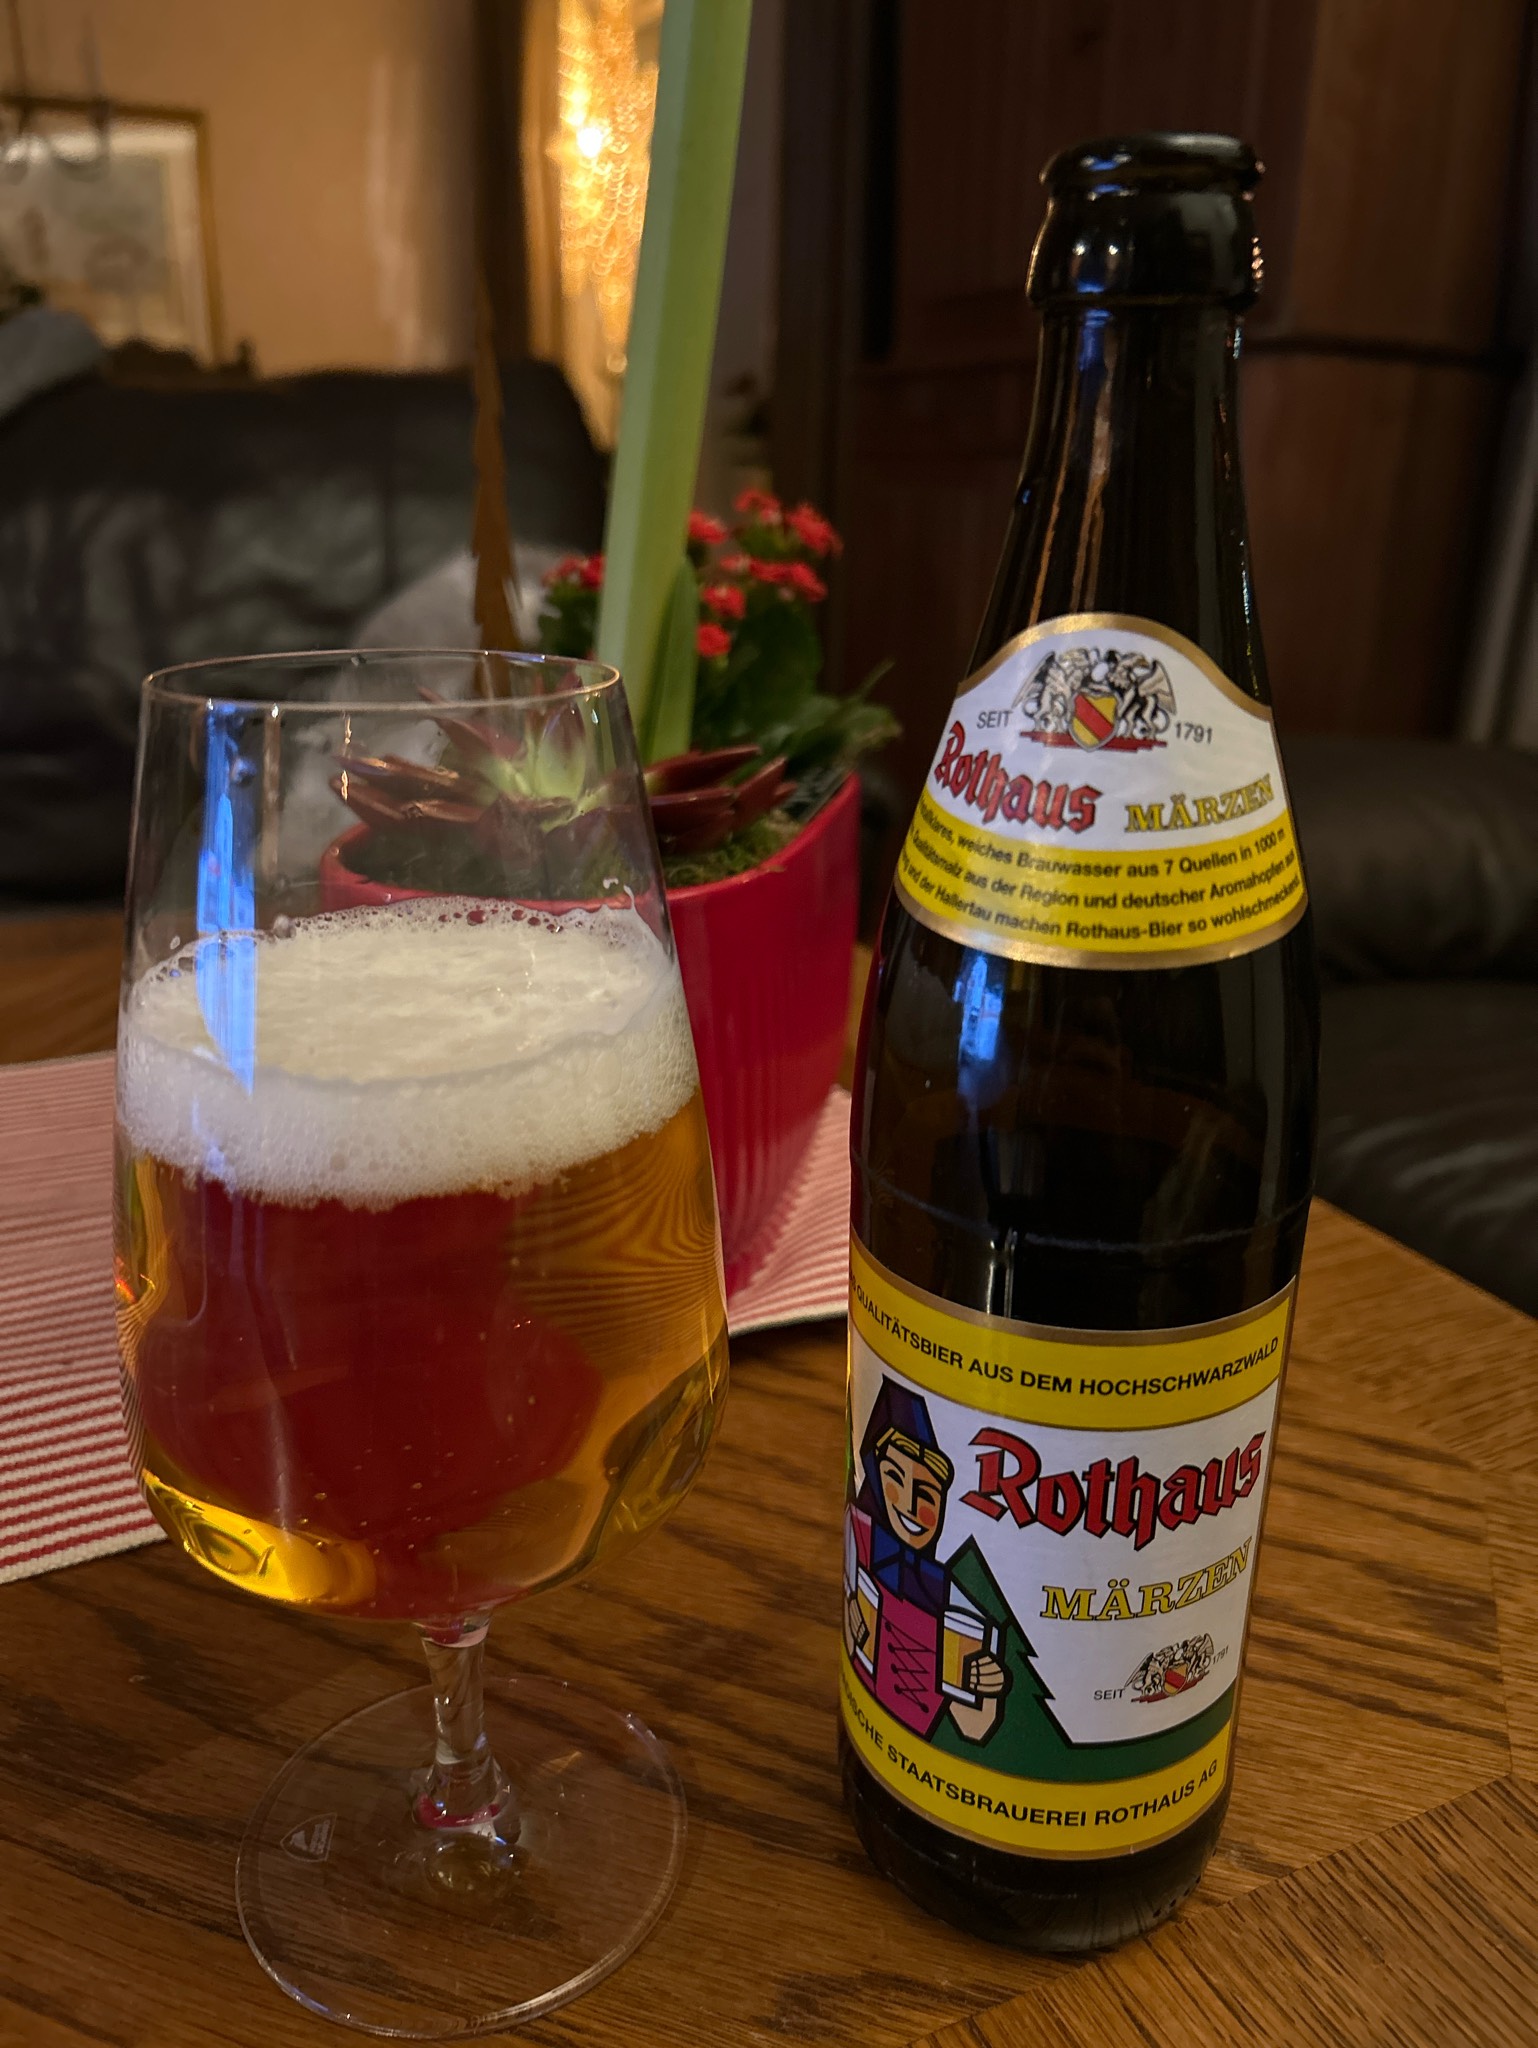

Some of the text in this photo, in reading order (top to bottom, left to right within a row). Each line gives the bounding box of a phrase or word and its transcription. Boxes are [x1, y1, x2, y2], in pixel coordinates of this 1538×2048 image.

[977, 710, 1213, 744] SEIT 1791
[934, 720, 1274, 834] Rothaus MÄRZEN
[957, 835, 1013, 864] weiches
[1016, 851, 1122, 878] Brauwasser
[1127, 863, 1159, 877] aus
[1163, 858, 1174, 876] 7
[1179, 851, 1238, 874] Quellen
[1239, 844, 1252, 862] in
[1254, 831, 1278, 854] 1000
[963, 870, 988, 889] aus
[990, 878, 1017, 896] der
[1019, 883, 1079, 908] Region
[1083, 892, 1118, 909] und
[1121, 888, 1205, 909] deutscher
[1210, 860, 1285, 900] Aromahopfen
[934, 885, 993, 922] Hallertau
[994, 909, 1061, 936] machen
[1065, 920, 1184, 939] Rothaus-Bier
[1187, 919, 1208, 934] so
[857, 1284, 1280, 1396] QUALITÄTSBIER AUS DEM HOCHSCHWARZWALD
[958, 1426, 1268, 1552] Rothaus
[1039, 1535, 1254, 1622] MÄRZEN
[1093, 1645, 1230, 1701] SEIT 1791
[887, 1743, 1087, 1828] STAATSBRAUEREI
[1094, 1779, 1195, 1827] ROTHAUS
[1196, 1759, 1219, 1791] AG
